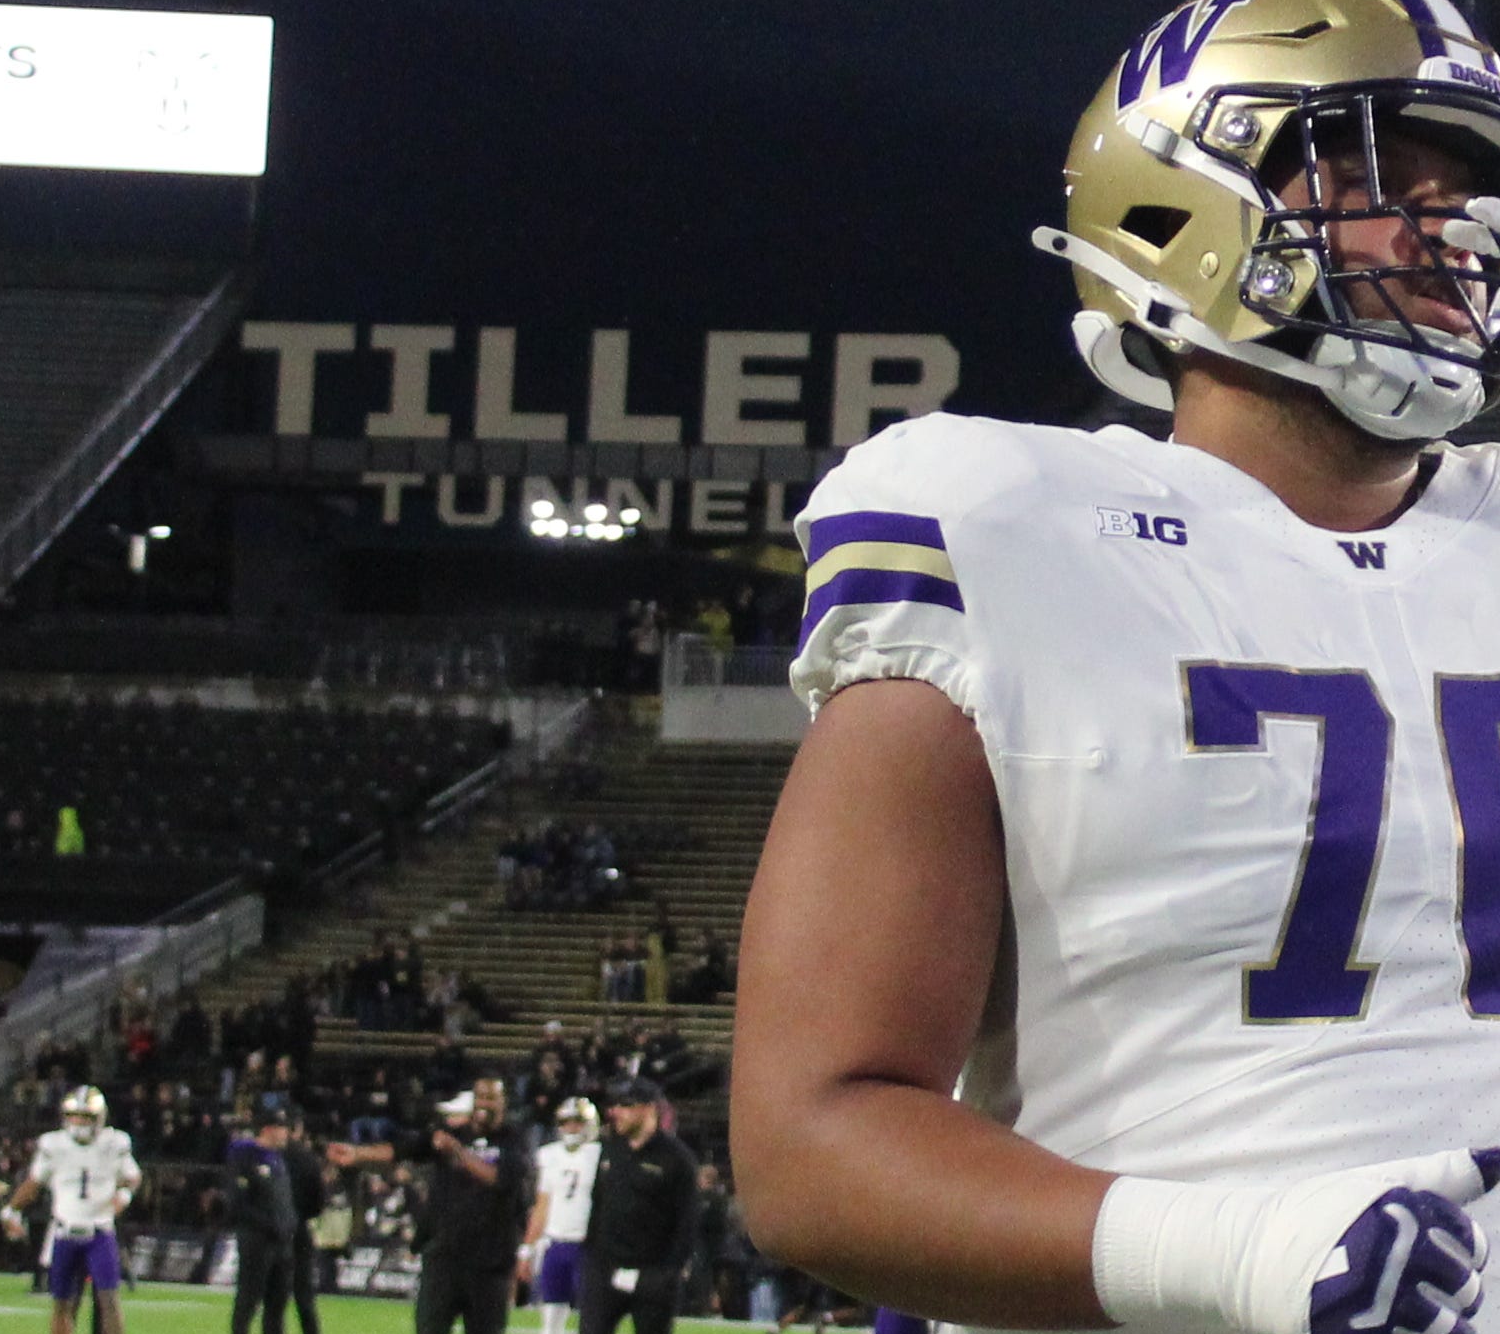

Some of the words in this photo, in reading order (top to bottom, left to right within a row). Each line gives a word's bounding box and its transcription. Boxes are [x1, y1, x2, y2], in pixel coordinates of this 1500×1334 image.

[241, 321, 961, 446] TILLER
[362, 471, 803, 534] TUNNEL
[1337, 540, 1388, 570] W
